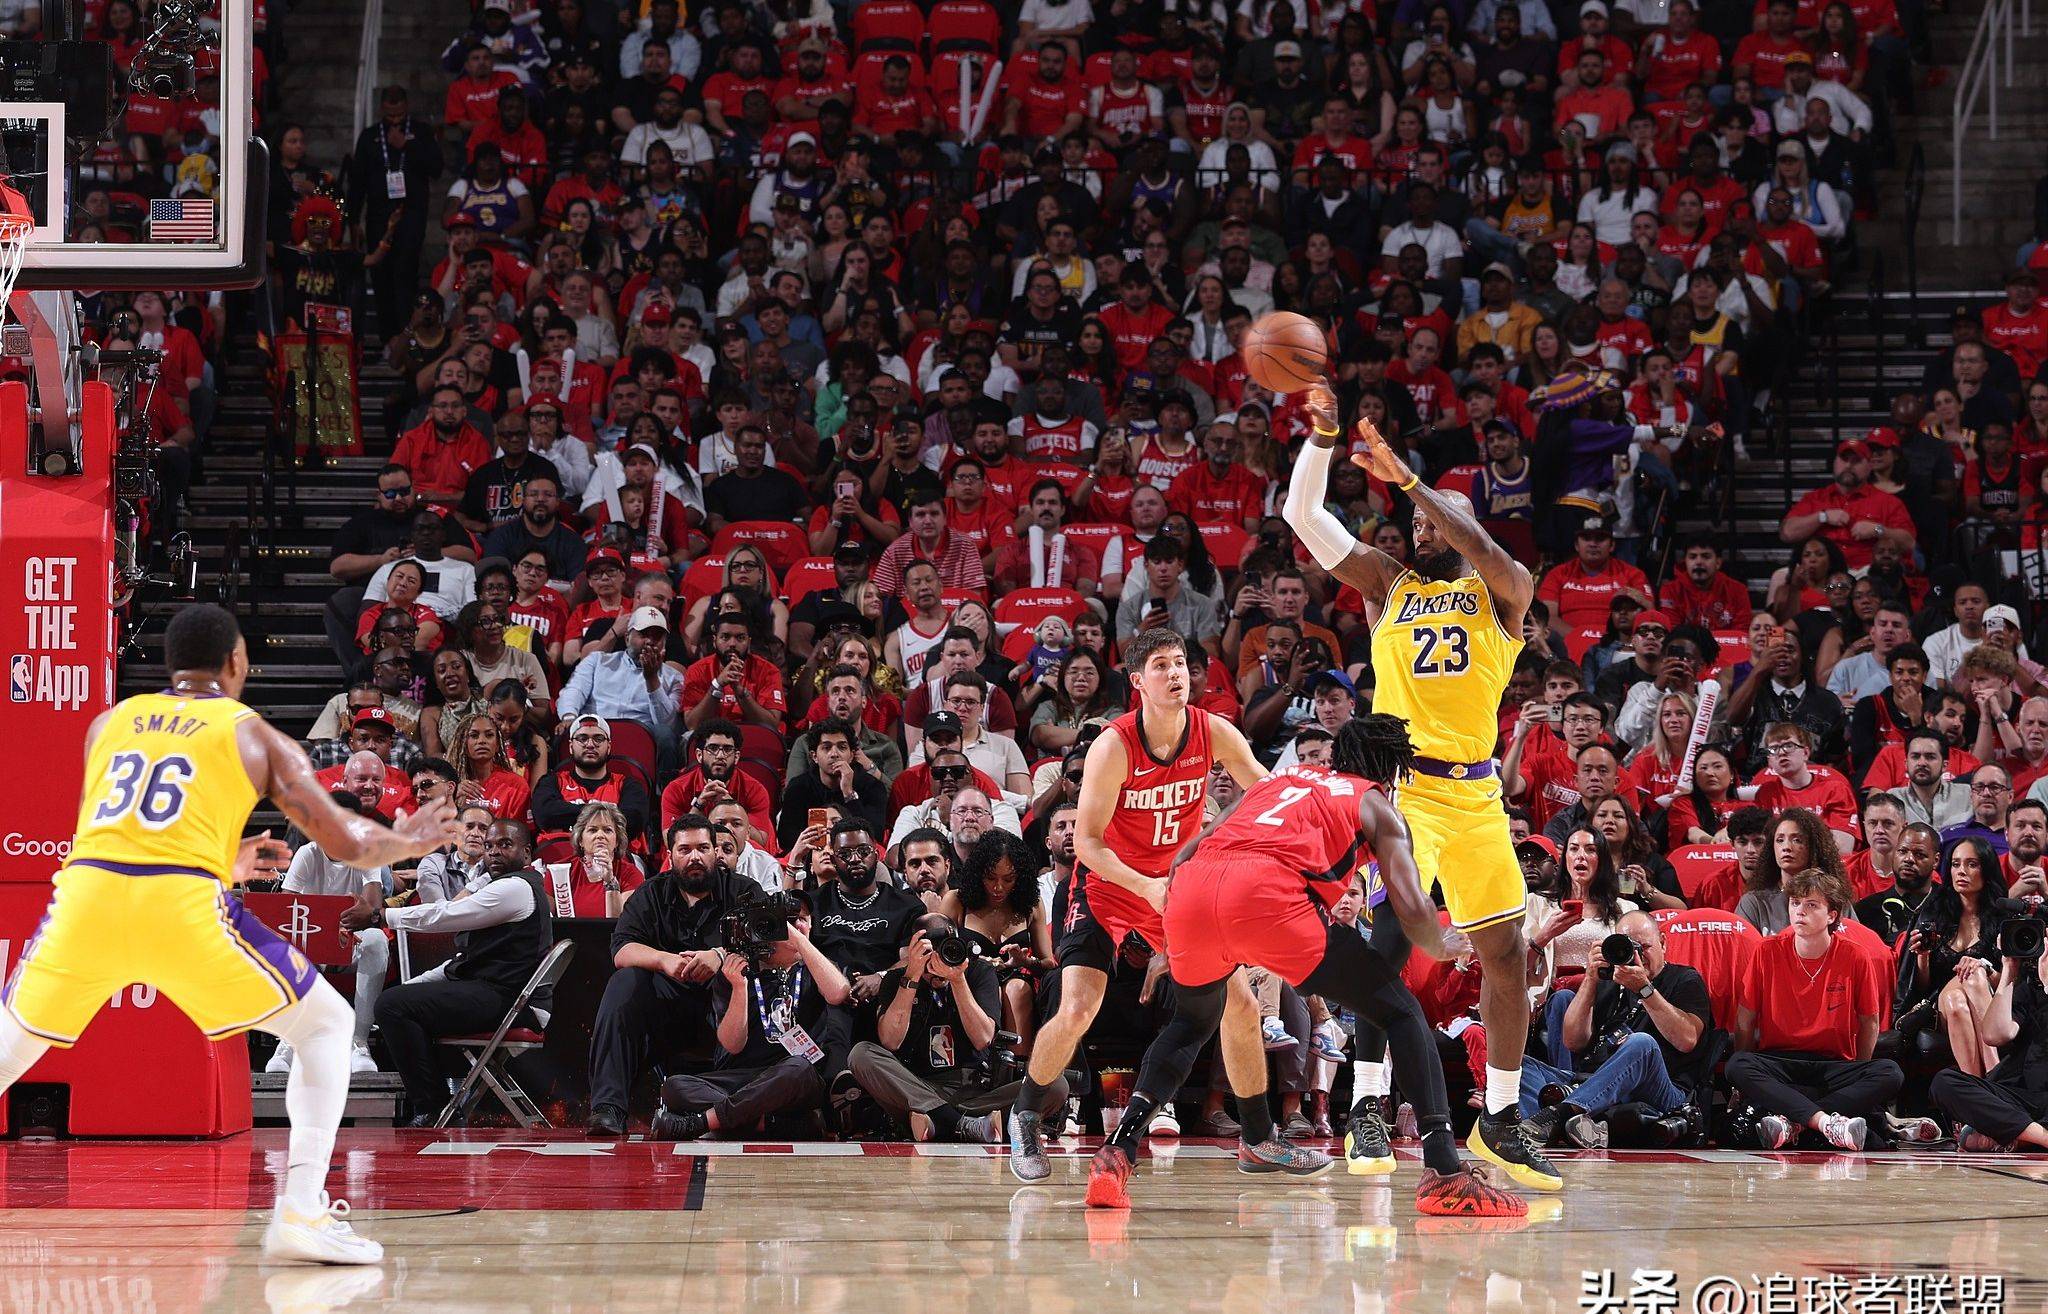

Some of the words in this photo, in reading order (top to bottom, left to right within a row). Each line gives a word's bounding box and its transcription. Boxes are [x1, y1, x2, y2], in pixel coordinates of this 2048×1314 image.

[1025, 434, 1077, 453] ROCKETS
[486, 484, 523, 511] HBC
[733, 530, 753, 539] ALL
[755, 531, 779, 539] FIRE
[705, 559, 725, 567] ALL
[24, 556, 77, 602] GET
[1563, 582, 1583, 591] ALL
[1584, 585, 1612, 593] FIRE
[941, 598, 961, 606] IRE
[1016, 599, 1035, 607] ALL
[1036, 598, 1063, 606] FIRE
[1393, 591, 1479, 625] LAKERS
[24, 606, 77, 650] THE
[511, 611, 549, 637] UTCH
[1582, 630, 1602, 638] ALL
[1412, 624, 1471, 678] 23
[13, 691, 25, 699] NBA
[35, 655, 90, 711] App
[133, 714, 209, 738] SMART
[1694, 693, 1716, 737] HOUSTON
[91, 750, 197, 831] 36
[1123, 777, 1206, 811] ROCKETS
[1254, 785, 1313, 827] 2
[1152, 809, 1181, 847] 15
[1686, 852, 1712, 860] ALL
[556, 883, 571, 916] OCKETS
[1670, 922, 1697, 933] ALL
[1698, 921, 1732, 932] FIRE
